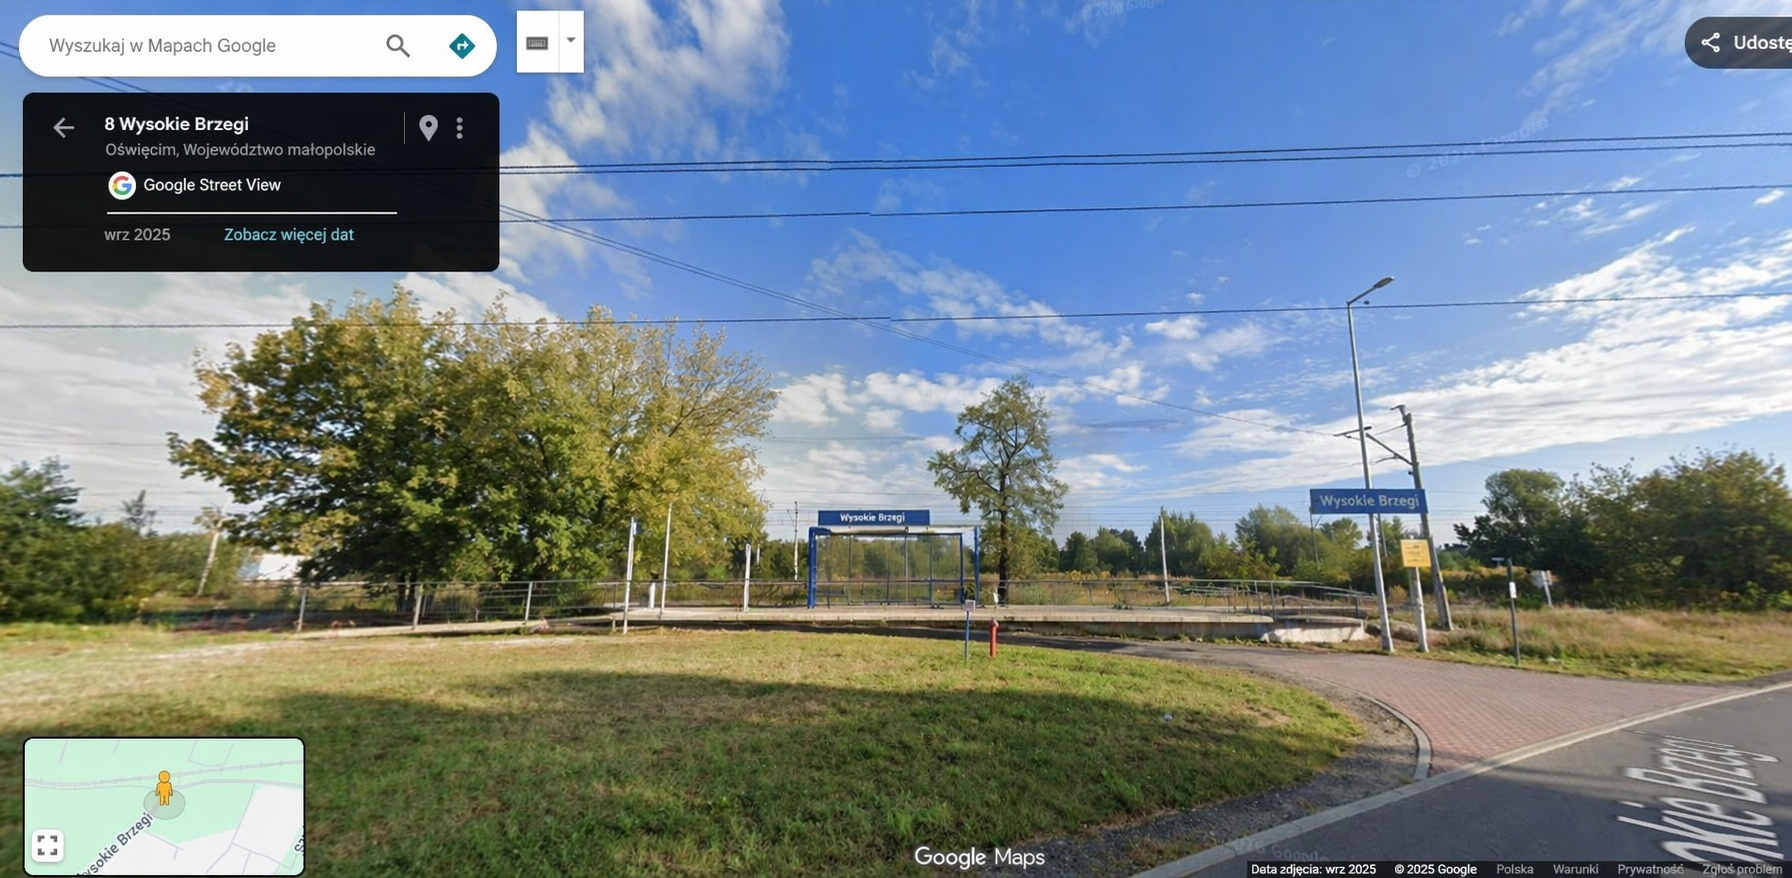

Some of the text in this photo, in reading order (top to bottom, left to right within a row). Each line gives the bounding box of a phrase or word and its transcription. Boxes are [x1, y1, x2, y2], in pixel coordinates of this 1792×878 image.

[1320, 494, 1420, 510] Wysokie Brzegi
[840, 512, 905, 524] Wysokie Brzegi
